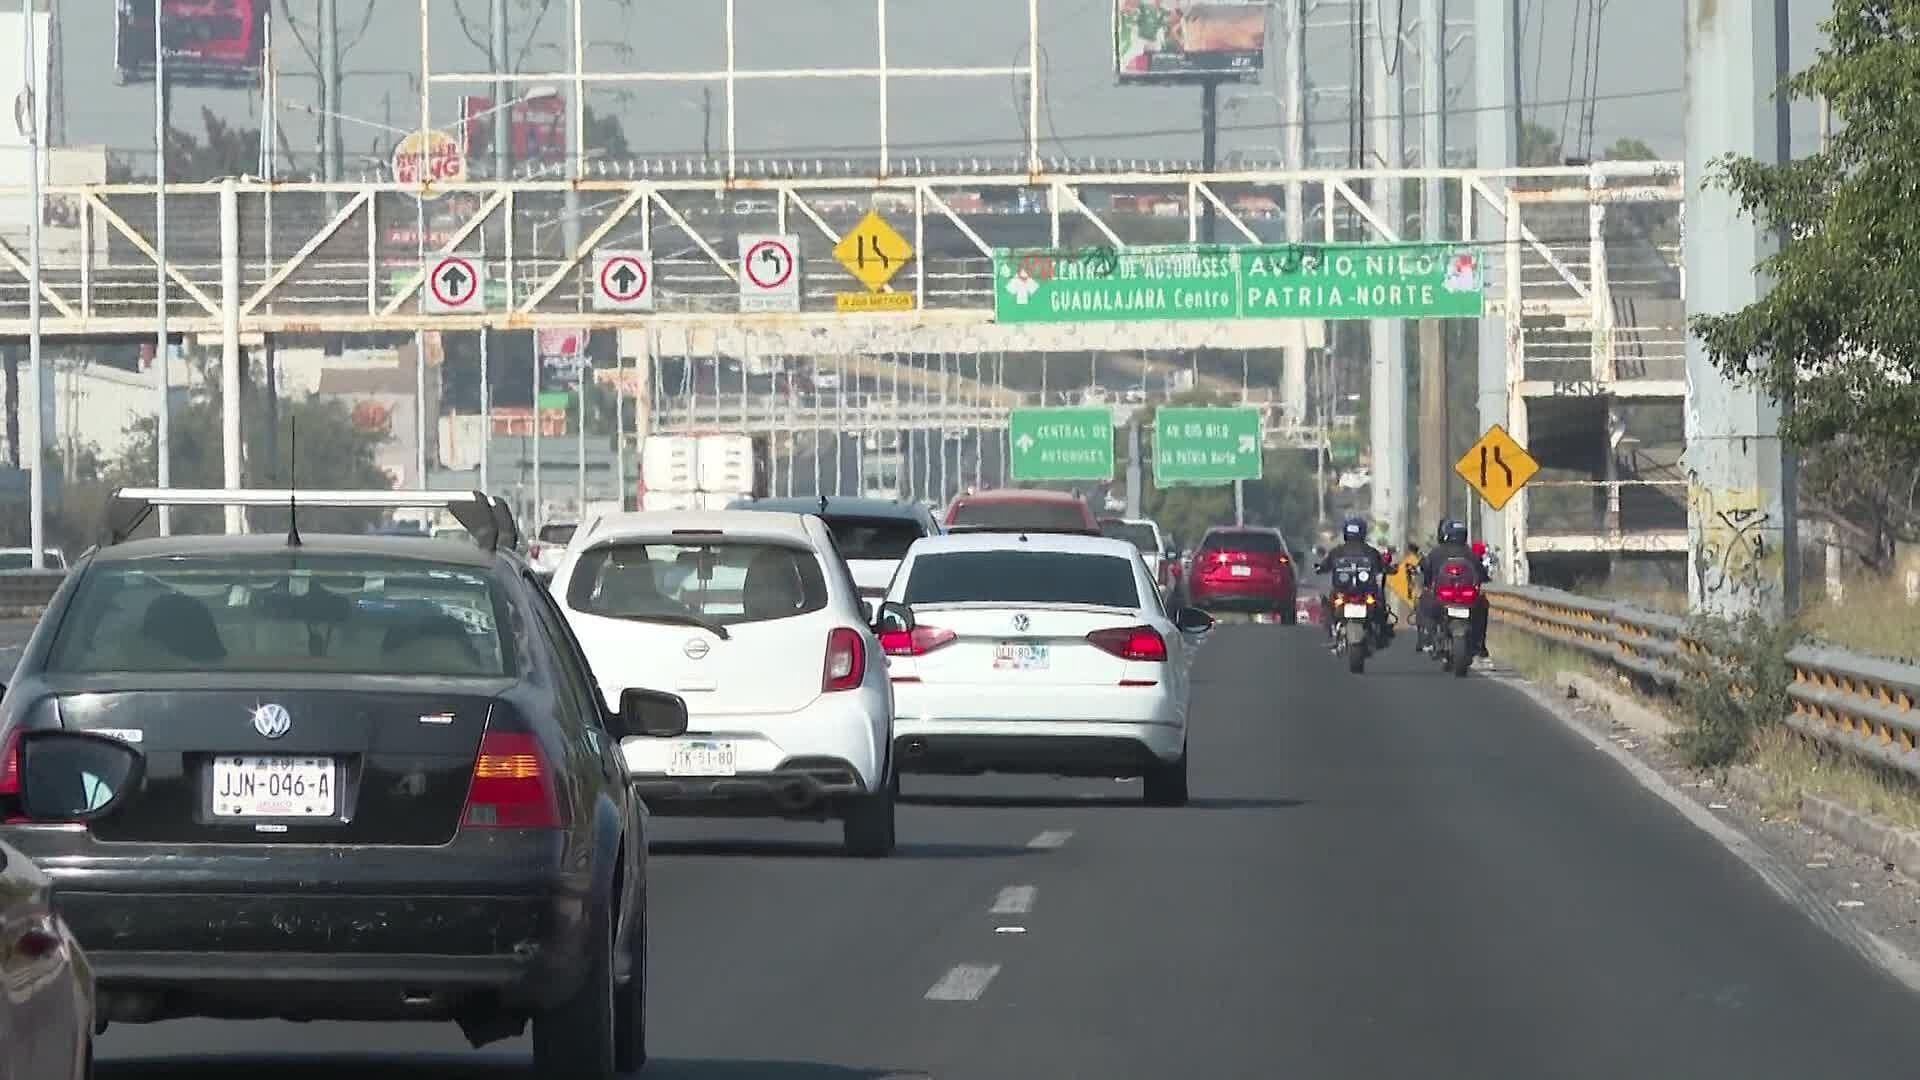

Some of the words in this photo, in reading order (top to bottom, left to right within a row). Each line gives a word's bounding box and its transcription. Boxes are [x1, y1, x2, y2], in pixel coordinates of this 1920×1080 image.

[1120, 256, 1138, 279] DE
[1050, 288, 1167, 312] GUADALAJARA
[1174, 287, 1230, 309] Centro
[220, 772, 329, 797] JJN-046-A
